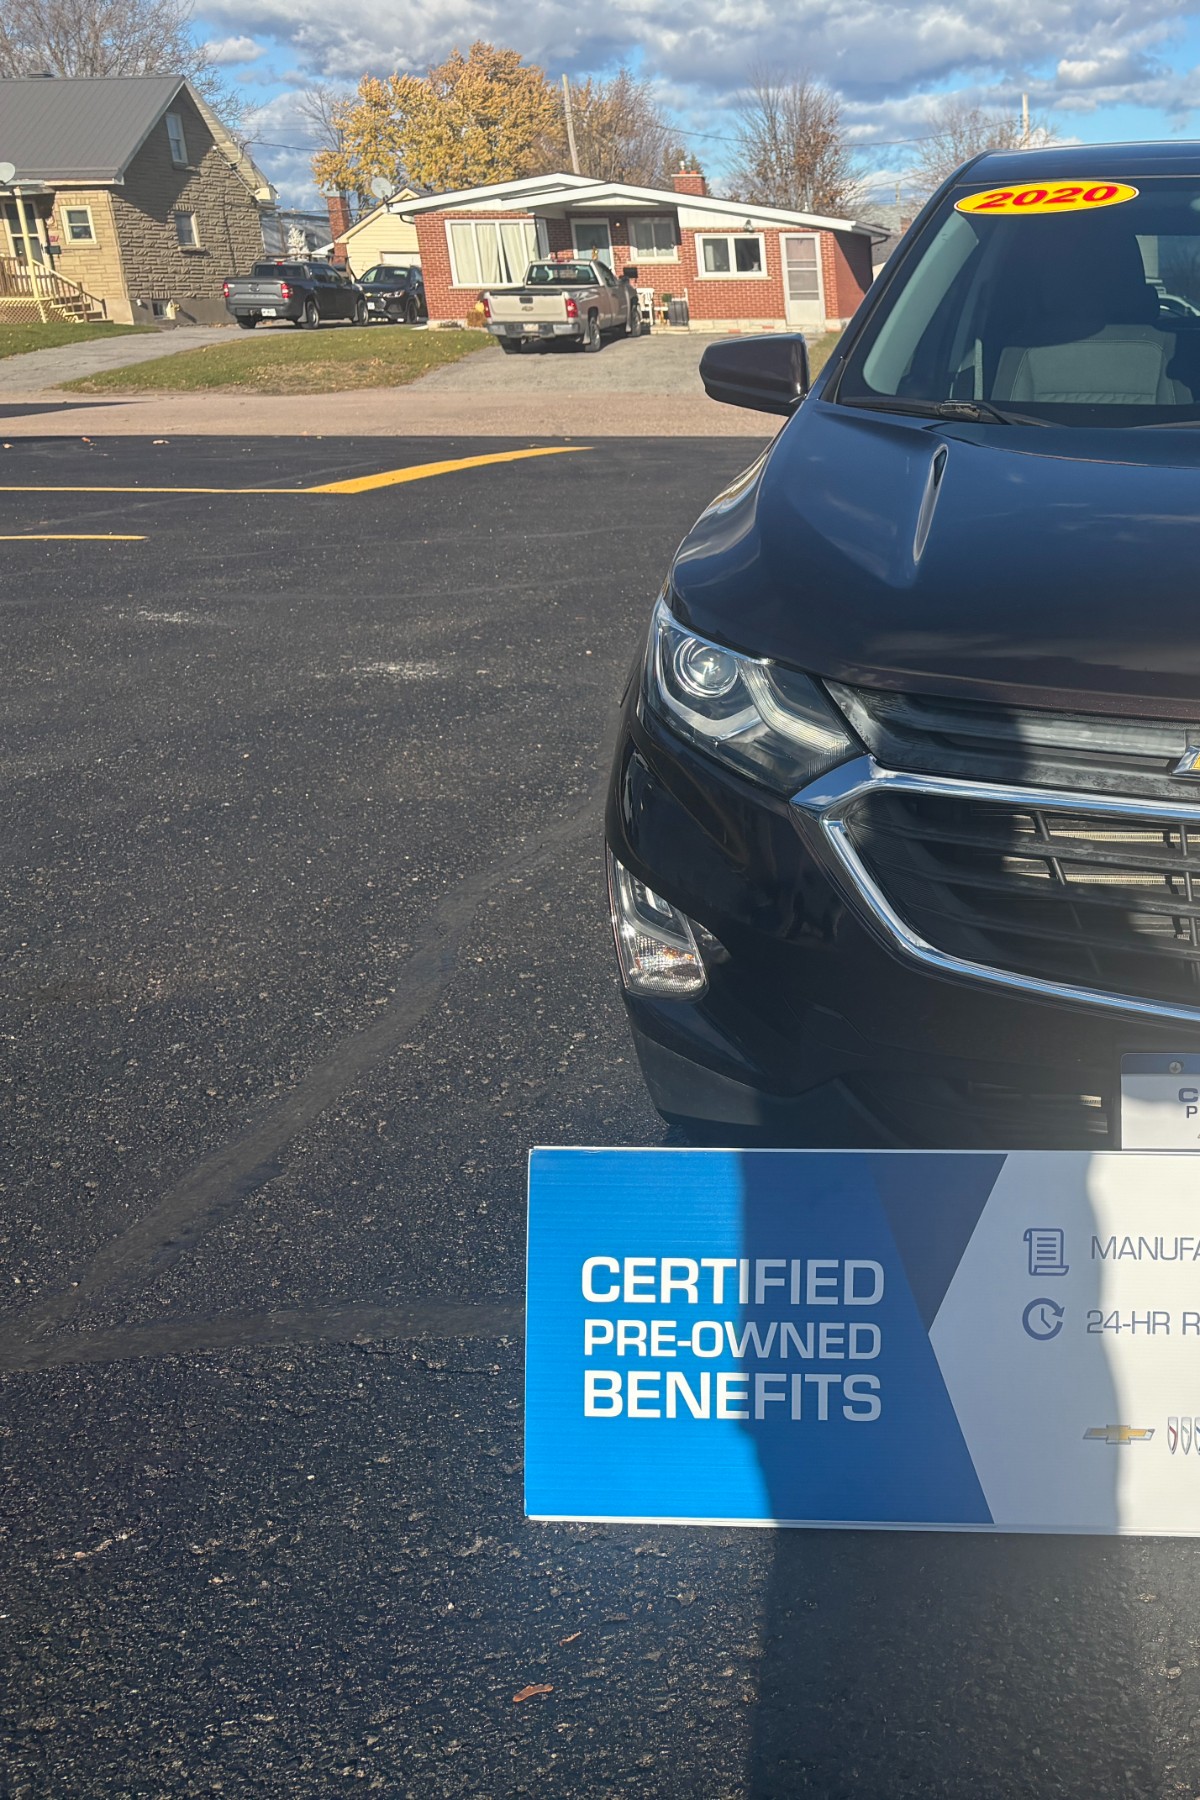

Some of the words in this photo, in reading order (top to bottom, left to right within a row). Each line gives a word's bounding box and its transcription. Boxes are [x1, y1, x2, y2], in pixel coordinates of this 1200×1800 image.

[973, 186, 1119, 210] 2020
[581, 1256, 885, 1305] CERTIFIED
[583, 1319, 882, 1360] PRE-OWNED
[1086, 1310, 1171, 1335] 24-HR
[583, 1370, 882, 1422] BENEFITS
